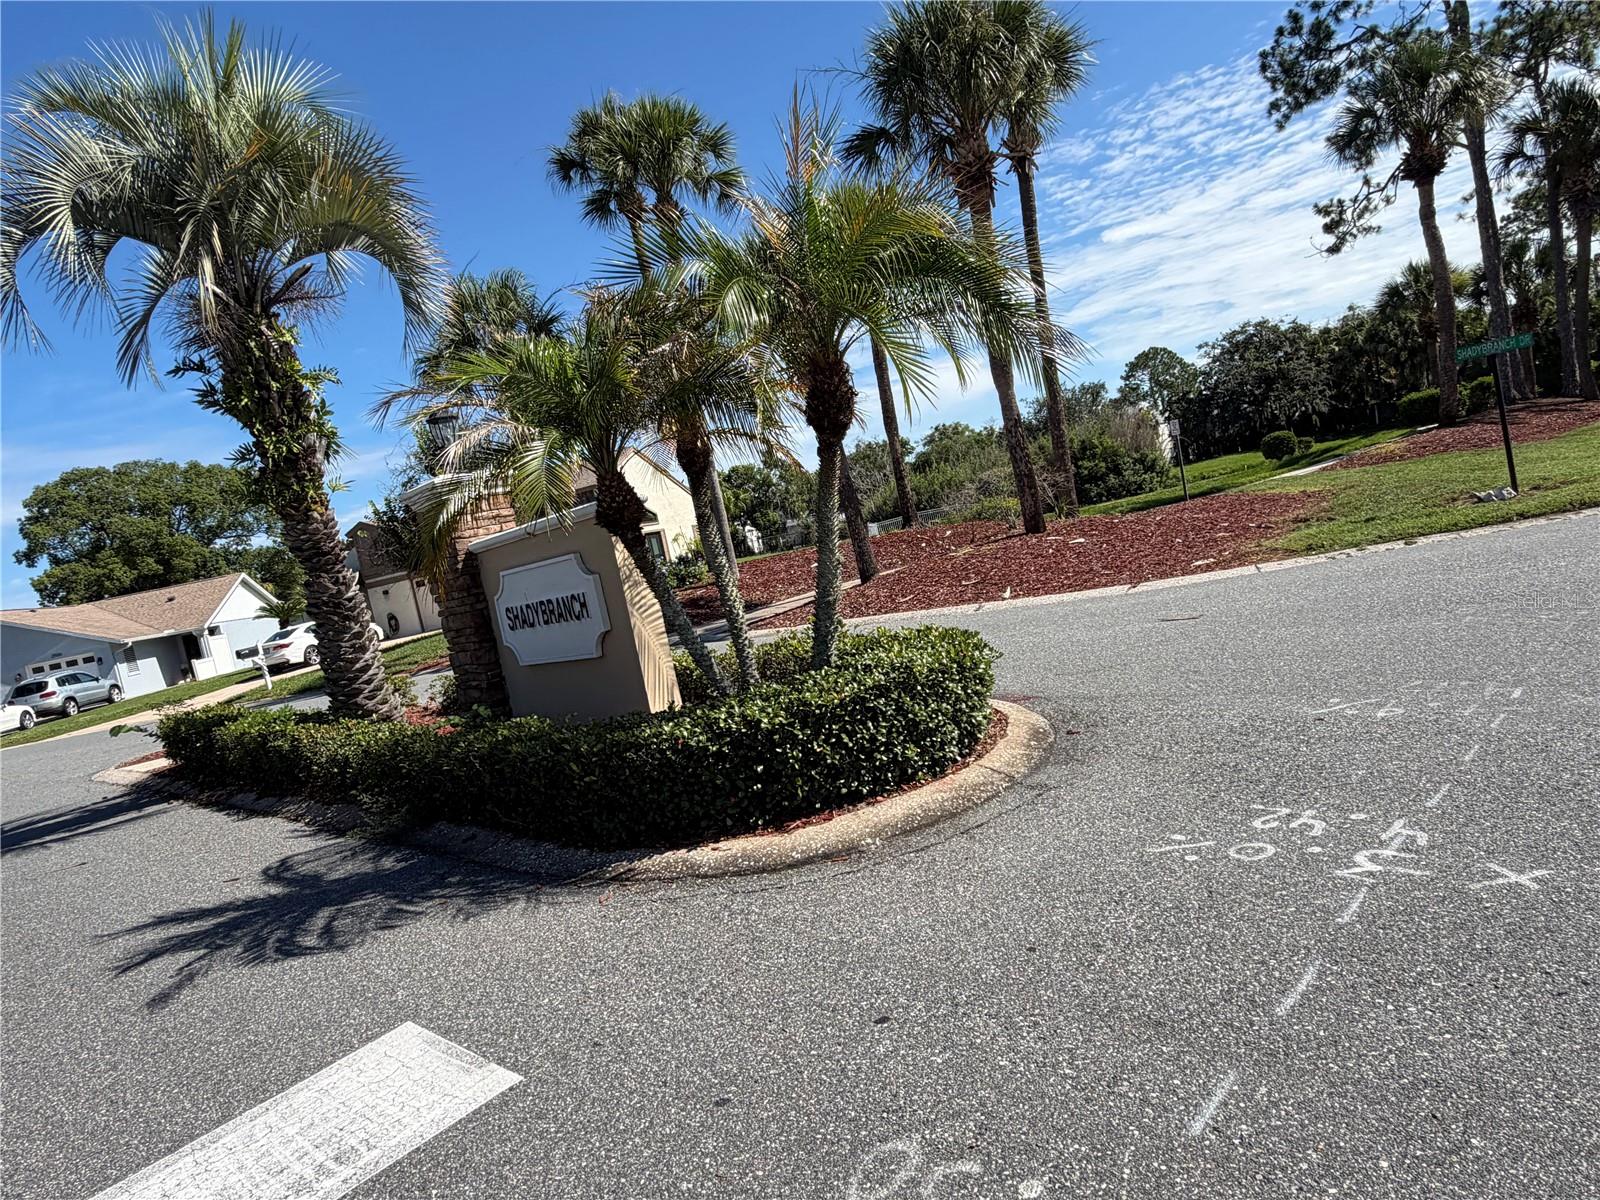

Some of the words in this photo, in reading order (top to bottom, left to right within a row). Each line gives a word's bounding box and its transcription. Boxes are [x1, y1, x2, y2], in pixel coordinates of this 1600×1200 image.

[1457, 338, 1515, 360] SHADYBRANCH
[1520, 335, 1532, 346] DR
[505, 592, 590, 632] SHADYBRANCH
